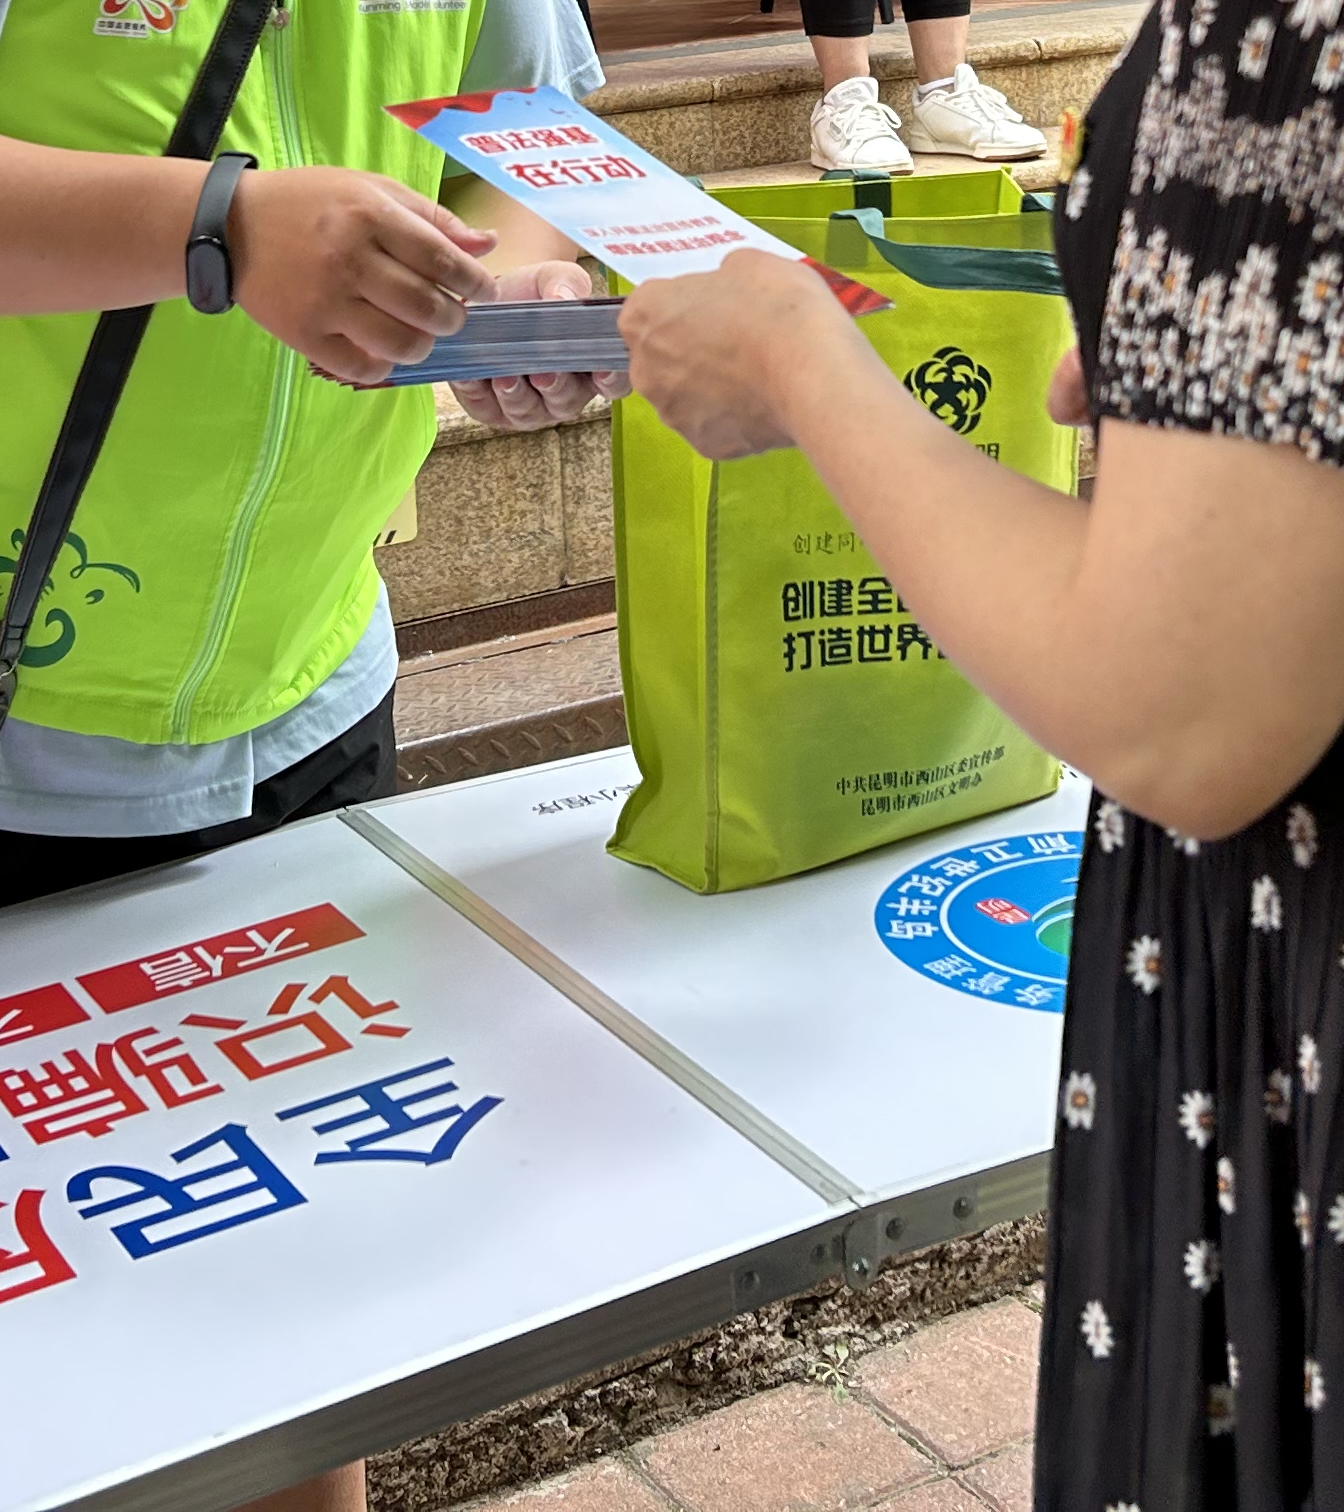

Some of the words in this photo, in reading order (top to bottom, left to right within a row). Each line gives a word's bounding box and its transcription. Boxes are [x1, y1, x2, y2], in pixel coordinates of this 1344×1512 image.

[463, 124, 600, 155] 普法强基
[505, 155, 647, 189] 在行动
[792, 531, 863, 555] 创建同
[781, 576, 910, 622] 创建全
[783, 622, 947, 672] 打造世界
[836, 745, 1005, 796] 中共昆明市西山区委宣传部
[860, 773, 982, 817] 昆明市西山区文明办
[138, 921, 308, 996] 不信
